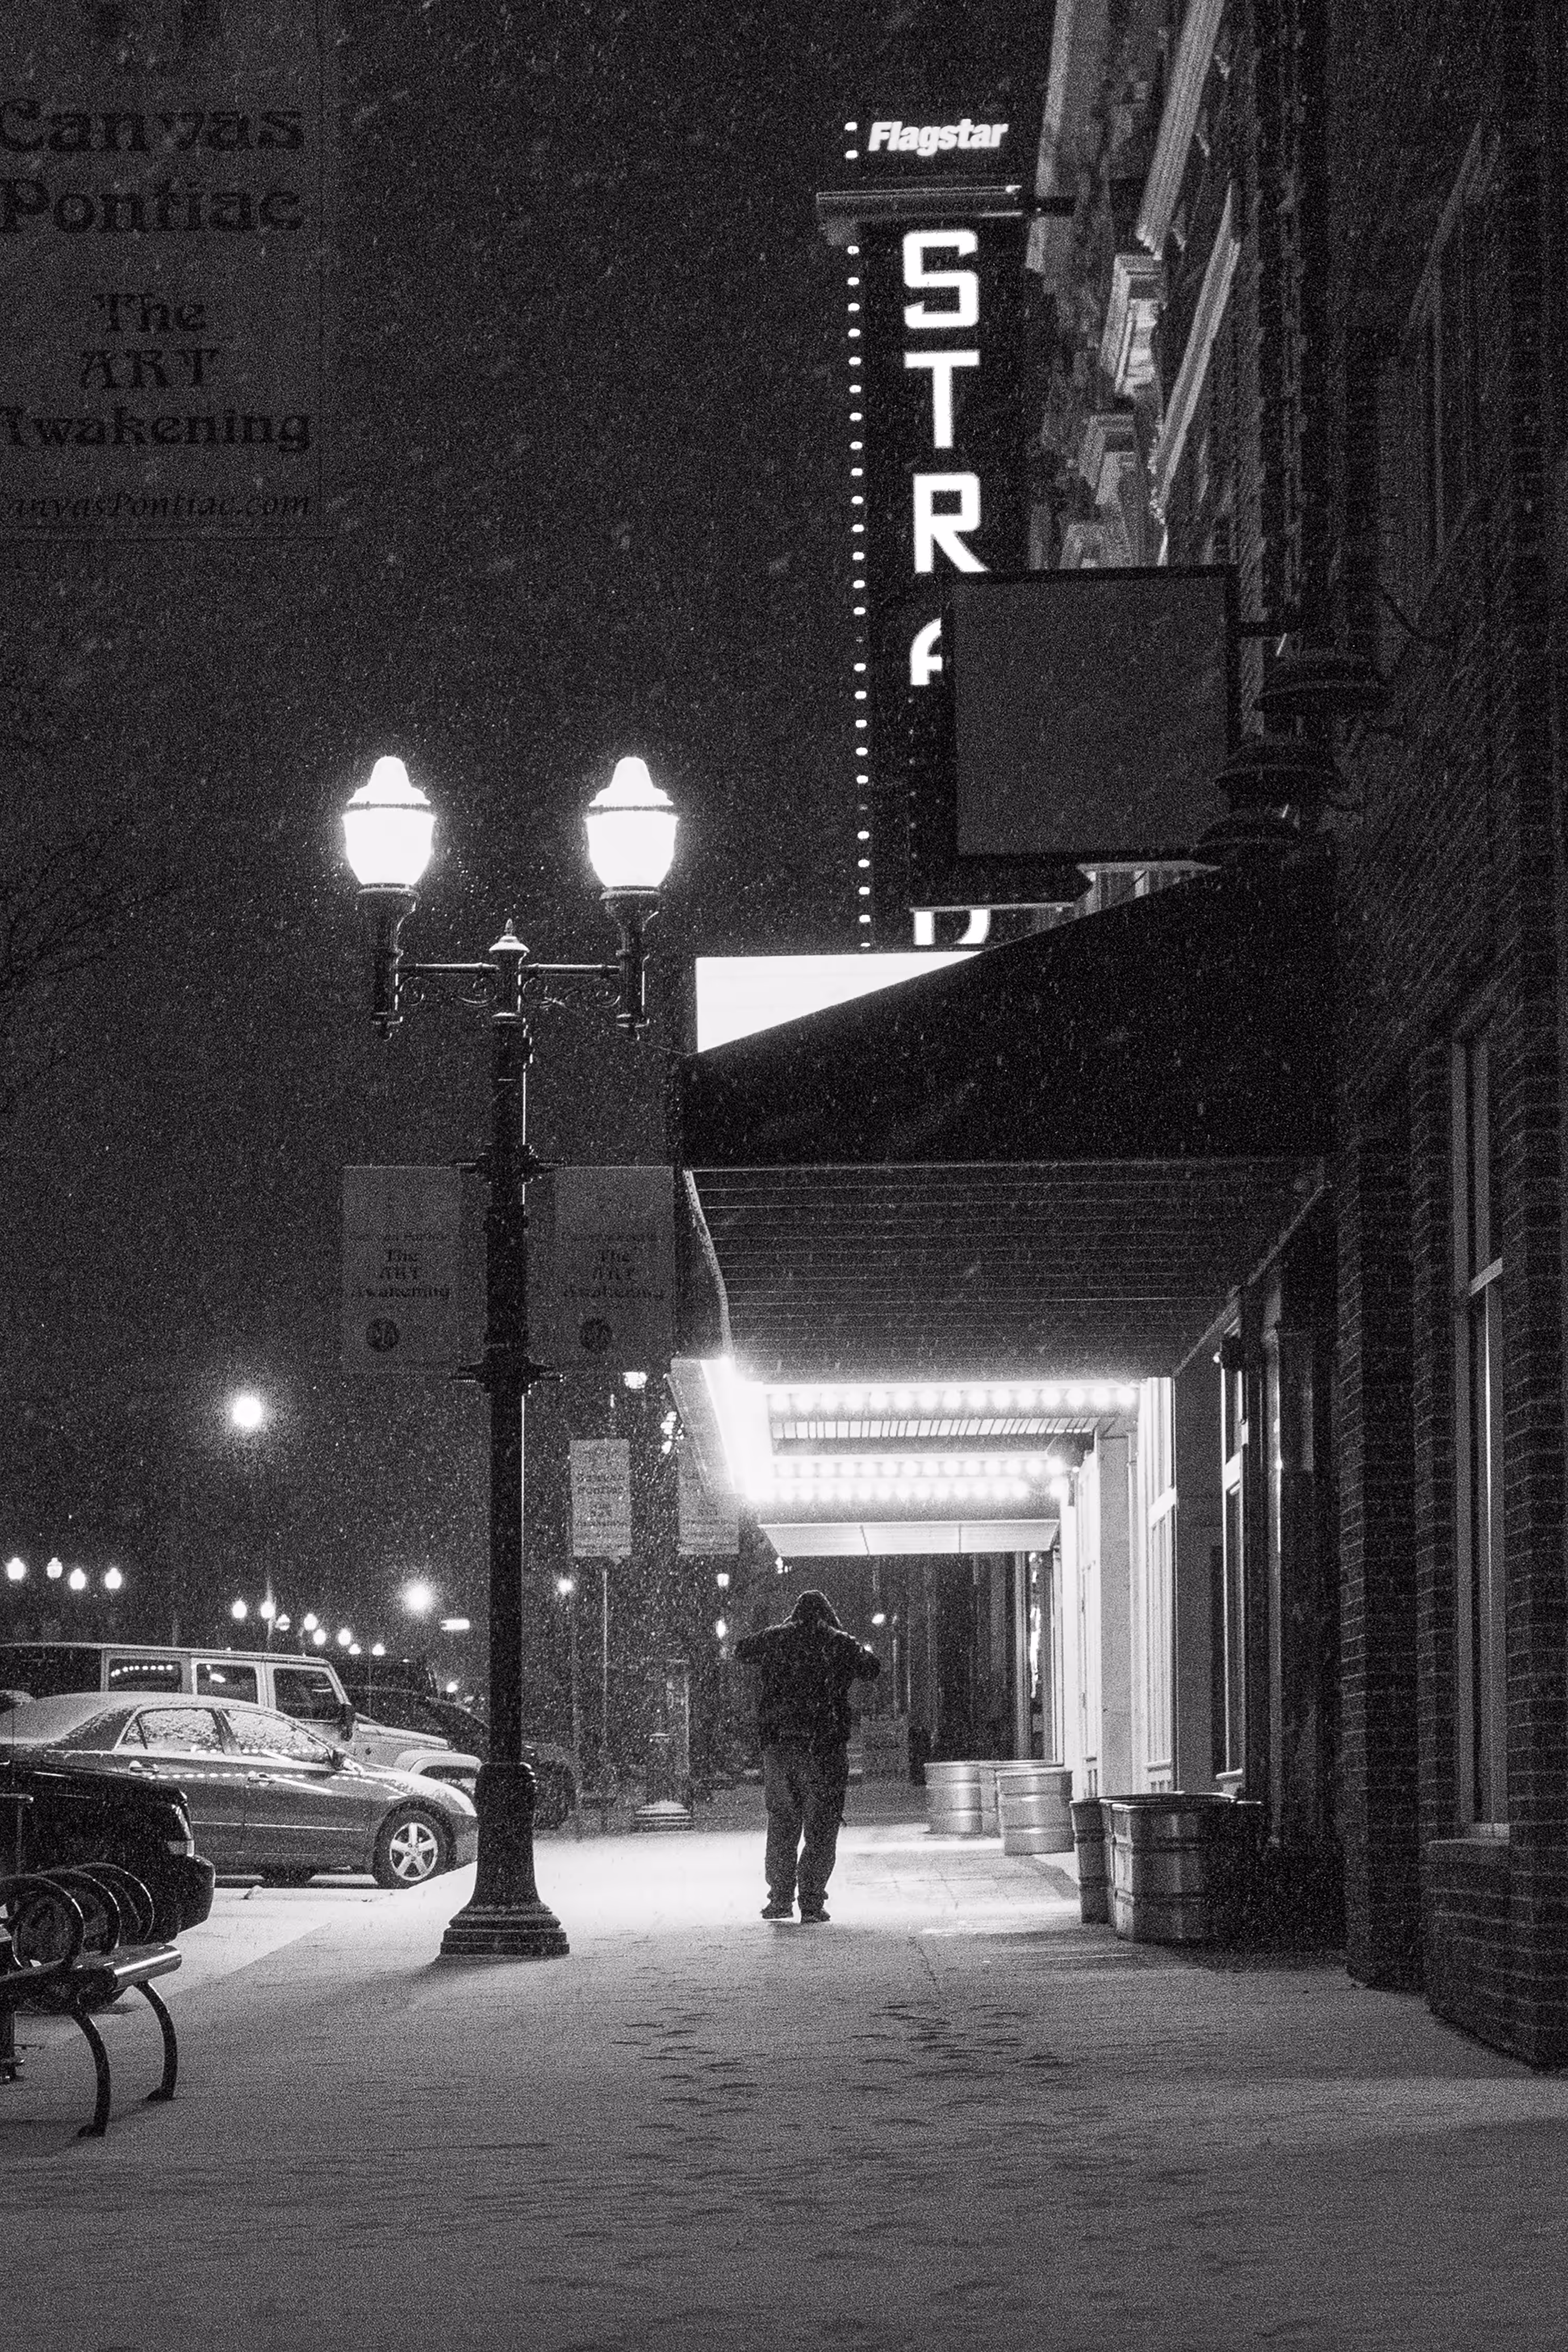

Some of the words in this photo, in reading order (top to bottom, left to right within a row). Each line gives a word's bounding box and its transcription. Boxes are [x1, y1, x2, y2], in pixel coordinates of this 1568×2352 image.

[0, 98, 304, 152] Canvas
[868, 119, 1009, 156] Flagstar
[0, 178, 304, 233] Pontiac
[93, 292, 206, 332] The
[80, 348, 220, 389] ART
